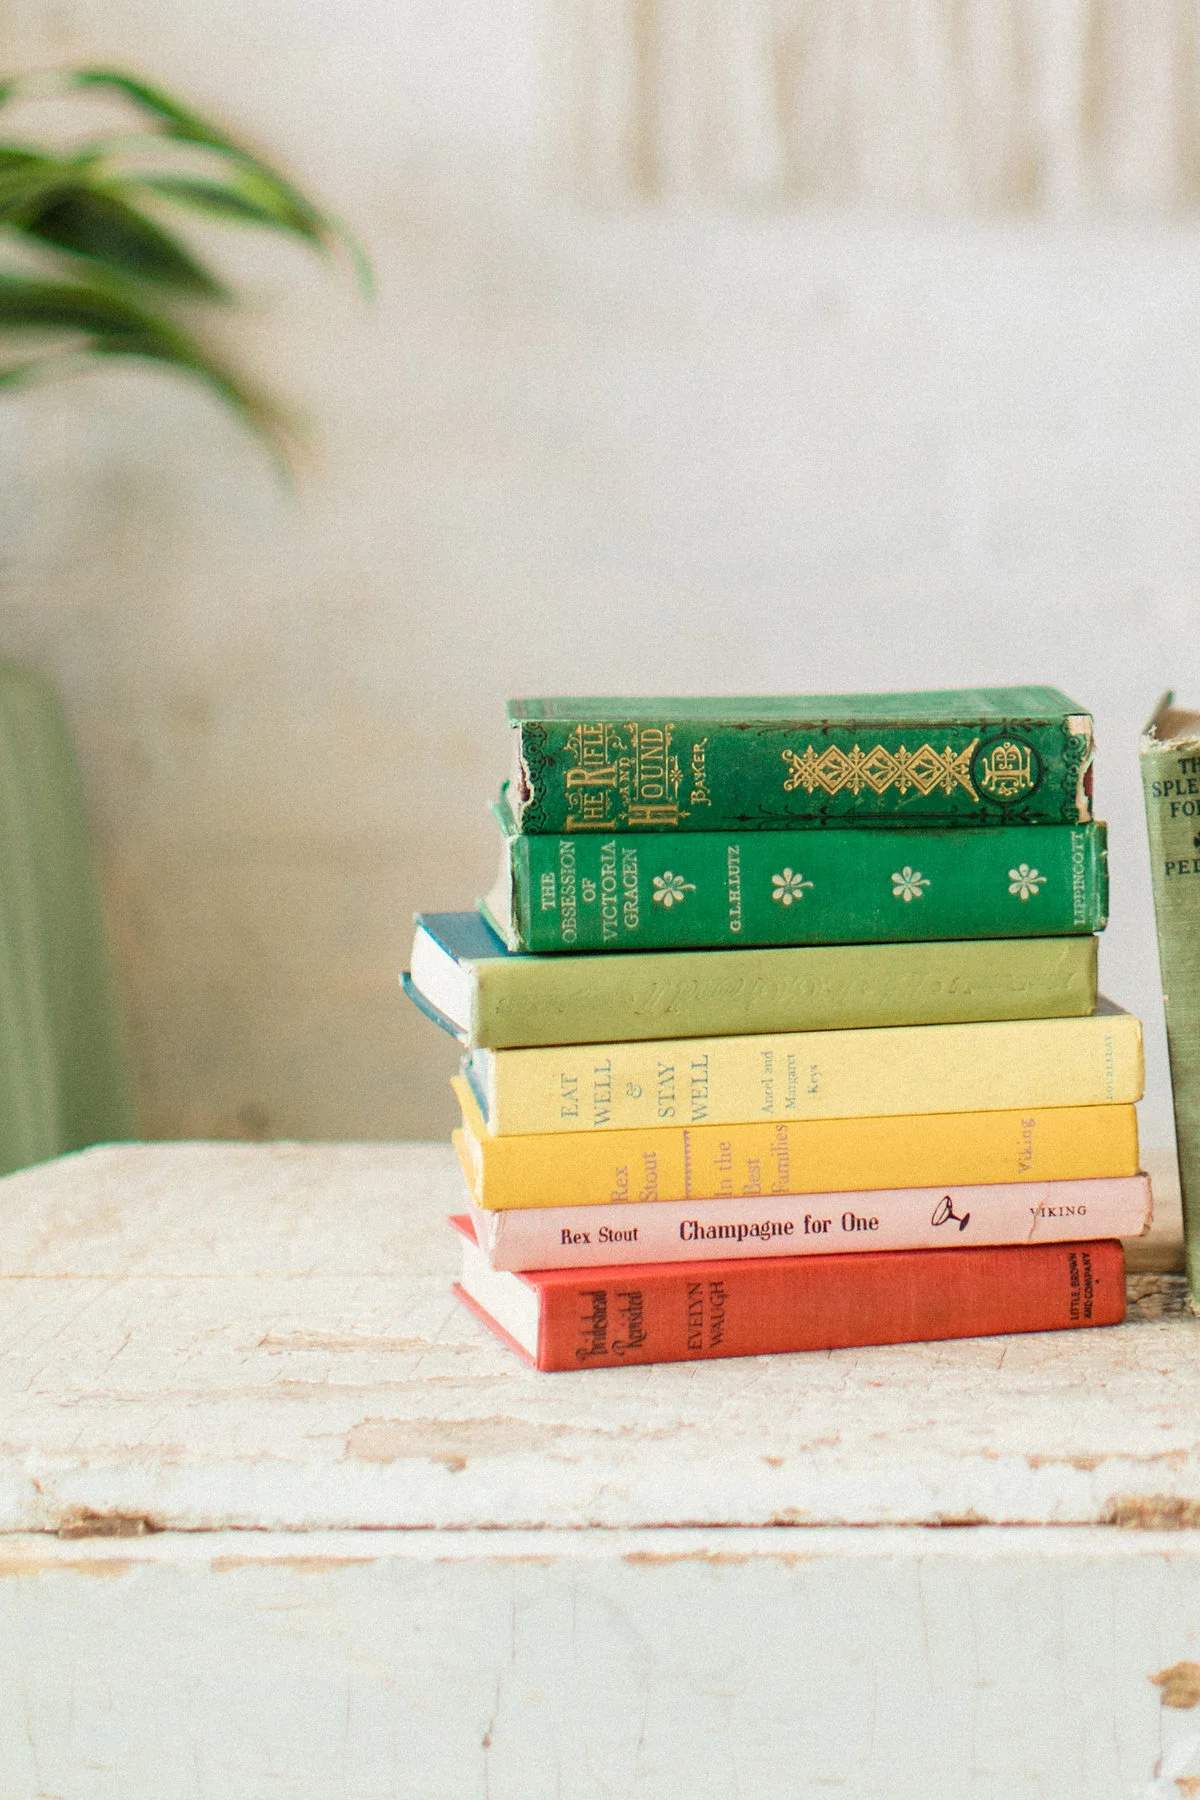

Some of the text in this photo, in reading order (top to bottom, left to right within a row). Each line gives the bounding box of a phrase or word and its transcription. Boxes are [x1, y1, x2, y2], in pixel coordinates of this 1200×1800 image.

[563, 722, 617, 833] THE RIFLE
[617, 756, 632, 795] AND
[627, 727, 679, 826] HOUND
[690, 737, 712, 807] BAKER
[541, 871, 556, 911] THE
[559, 839, 578, 944] OBSESSION
[582, 877, 597, 902] OF
[600, 839, 618, 942] VICTORIA
[622, 847, 640, 929] GRACEN
[1070, 830, 1086, 926] LIPPINCOTT
[560, 1072, 579, 1119] EAT
[593, 1058, 613, 1128] WELL
[625, 1081, 643, 1099] &
[657, 1061, 676, 1119] STAY
[691, 1054, 709, 1124] WELL
[761, 1050, 774, 1114] Ancel and
[784, 1053, 800, 1110] Margaret
[807, 1064, 823, 1094] Keys
[714, 1140, 732, 1199] In the
[769, 1124, 790, 1195] Families
[1017, 1117, 1037, 1174] Viking
[611, 1165, 629, 1201] Rex
[640, 1151, 659, 1201] Stout
[742, 1156, 761, 1198] Best
[561, 1226, 639, 1246] Rex Stout
[679, 1211, 880, 1243] Champagne for One
[1030, 1204, 1088, 1219] VIKING
[1068, 1252, 1079, 1287] BROWN
[1082, 1252, 1093, 1320] AND COMPANY
[687, 1281, 703, 1351] EVELYN
[709, 1280, 729, 1350] WAUGH
